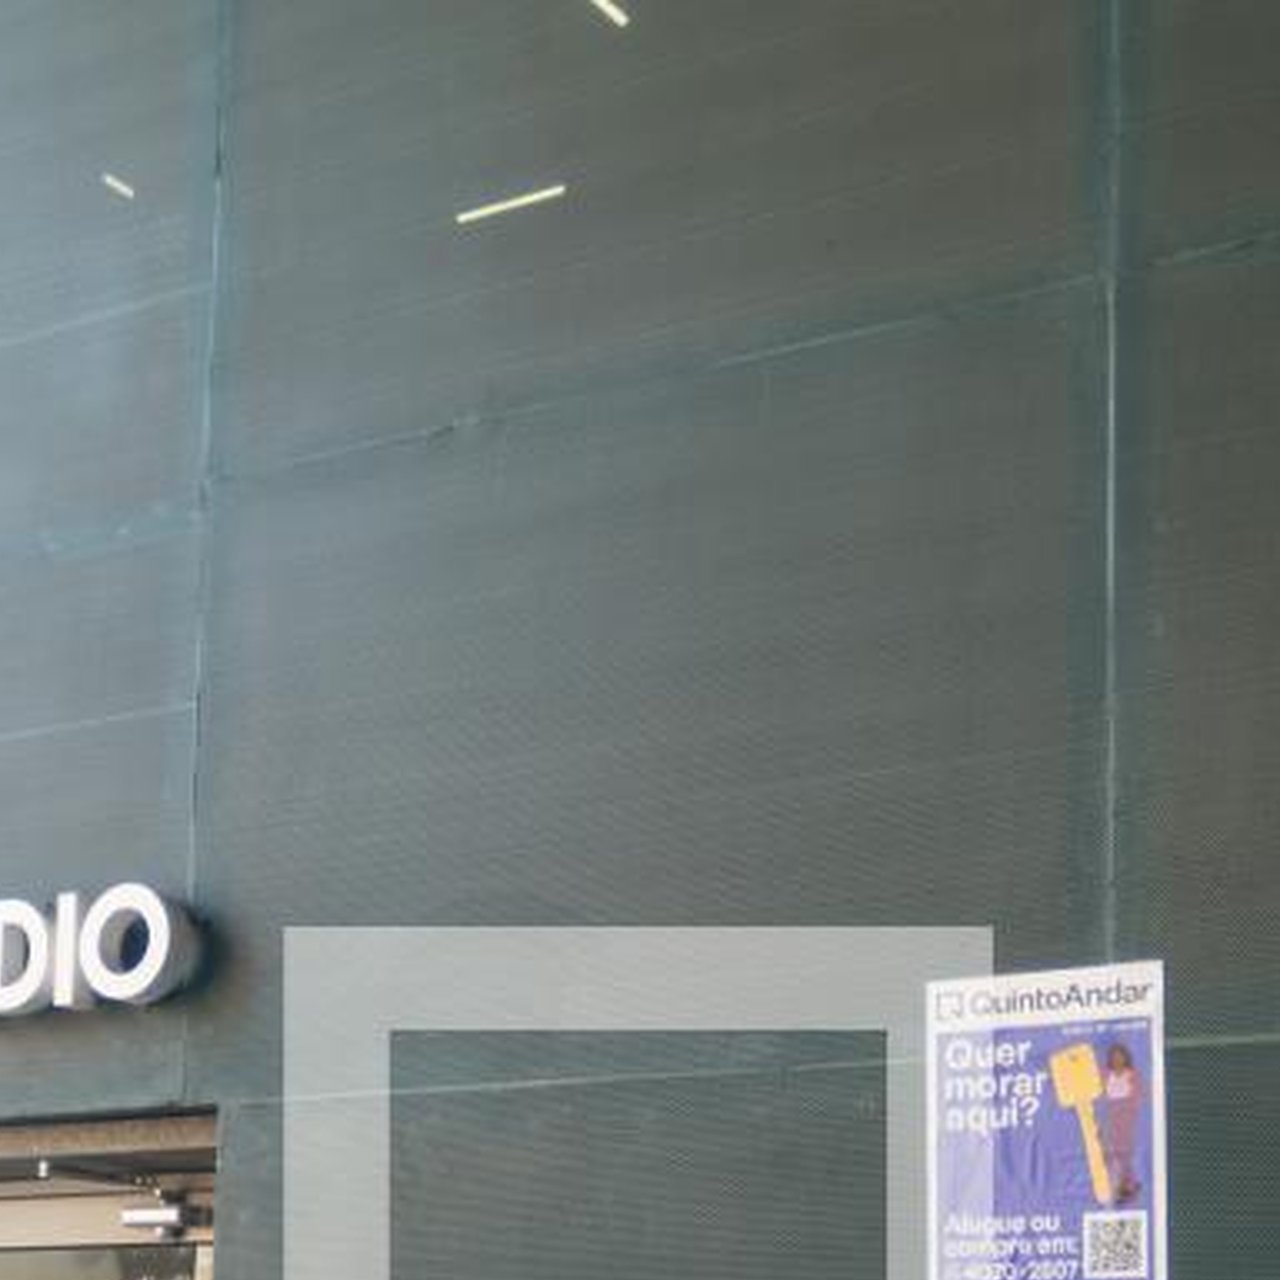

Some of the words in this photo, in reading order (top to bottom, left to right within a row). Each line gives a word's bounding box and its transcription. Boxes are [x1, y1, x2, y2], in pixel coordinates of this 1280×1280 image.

[970, 977, 1153, 1016] QuintoAndar
[944, 1038, 1033, 1070] Quer
[944, 1071, 1048, 1101] morar
[945, 1096, 1041, 1138] aqui?
[1030, 1214, 1061, 1233] ou
